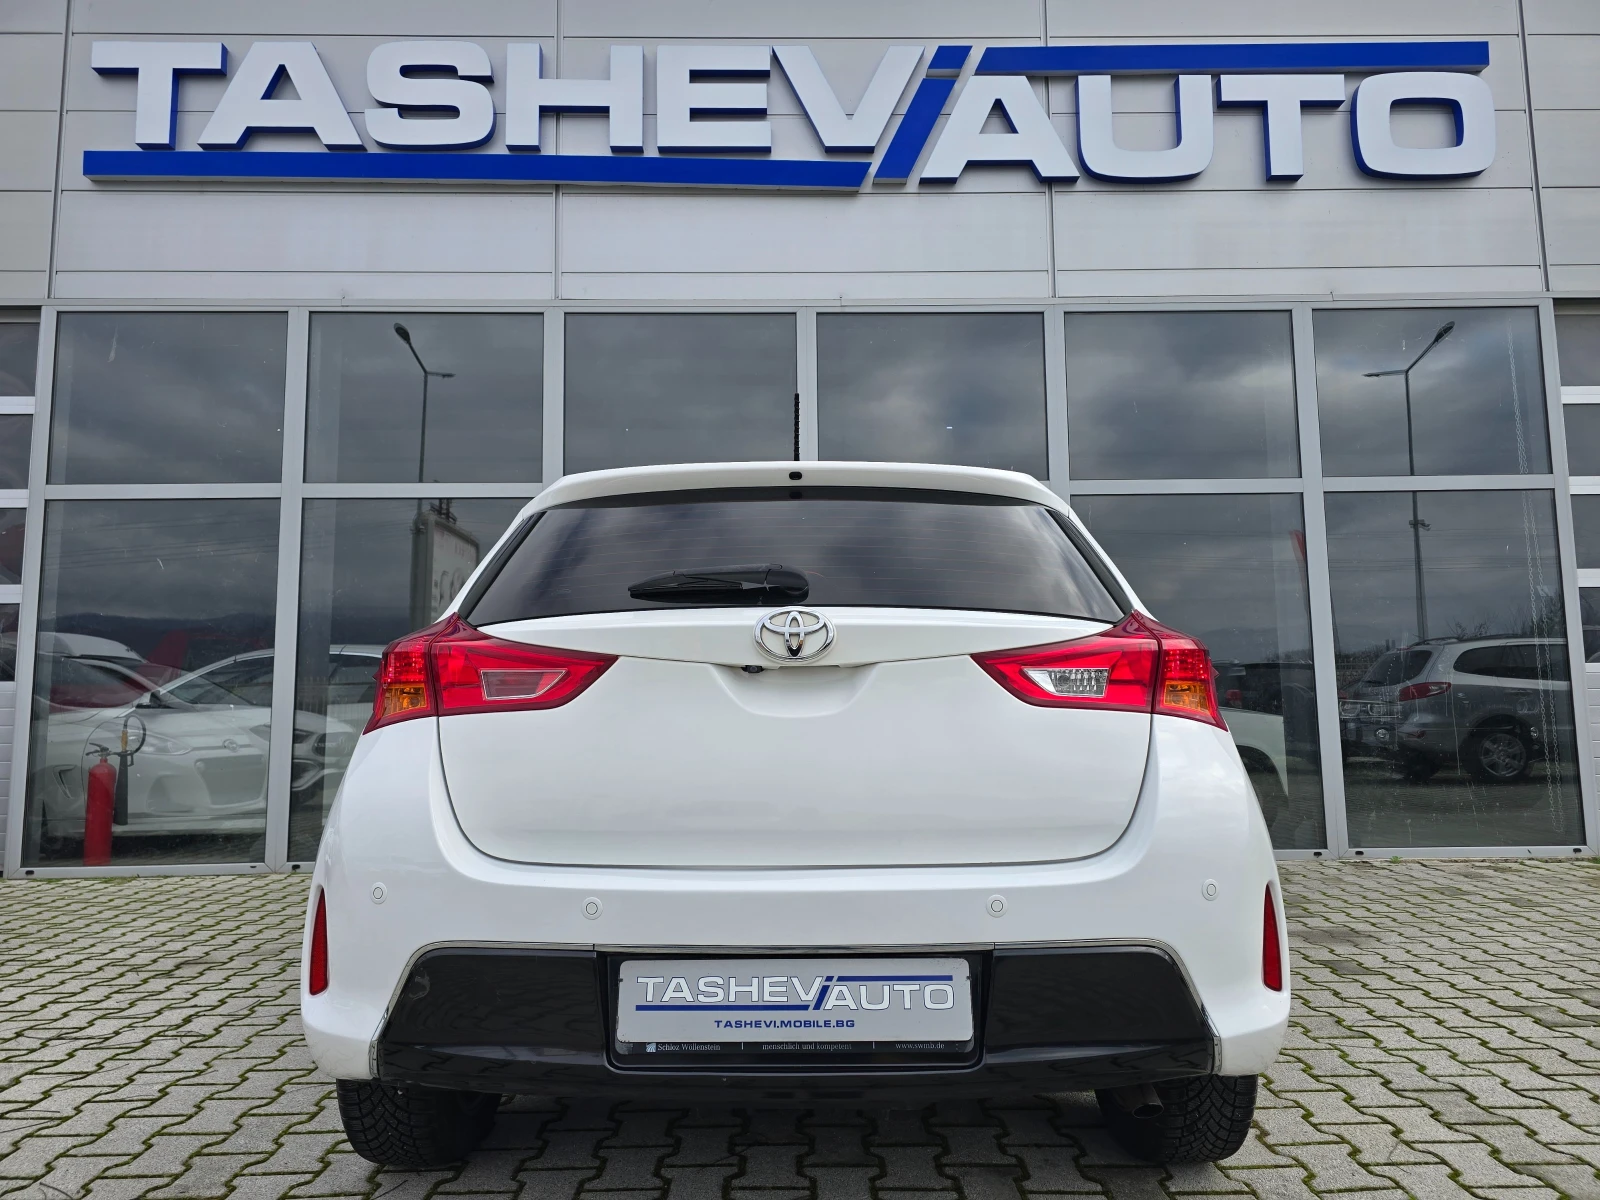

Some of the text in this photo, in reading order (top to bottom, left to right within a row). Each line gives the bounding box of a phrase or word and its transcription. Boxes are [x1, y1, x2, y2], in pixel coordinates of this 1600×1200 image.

[714, 1019, 856, 1030] TASHEVI.MOBILE.BG
[762, 1042, 852, 1051] menschlich und kompetent
